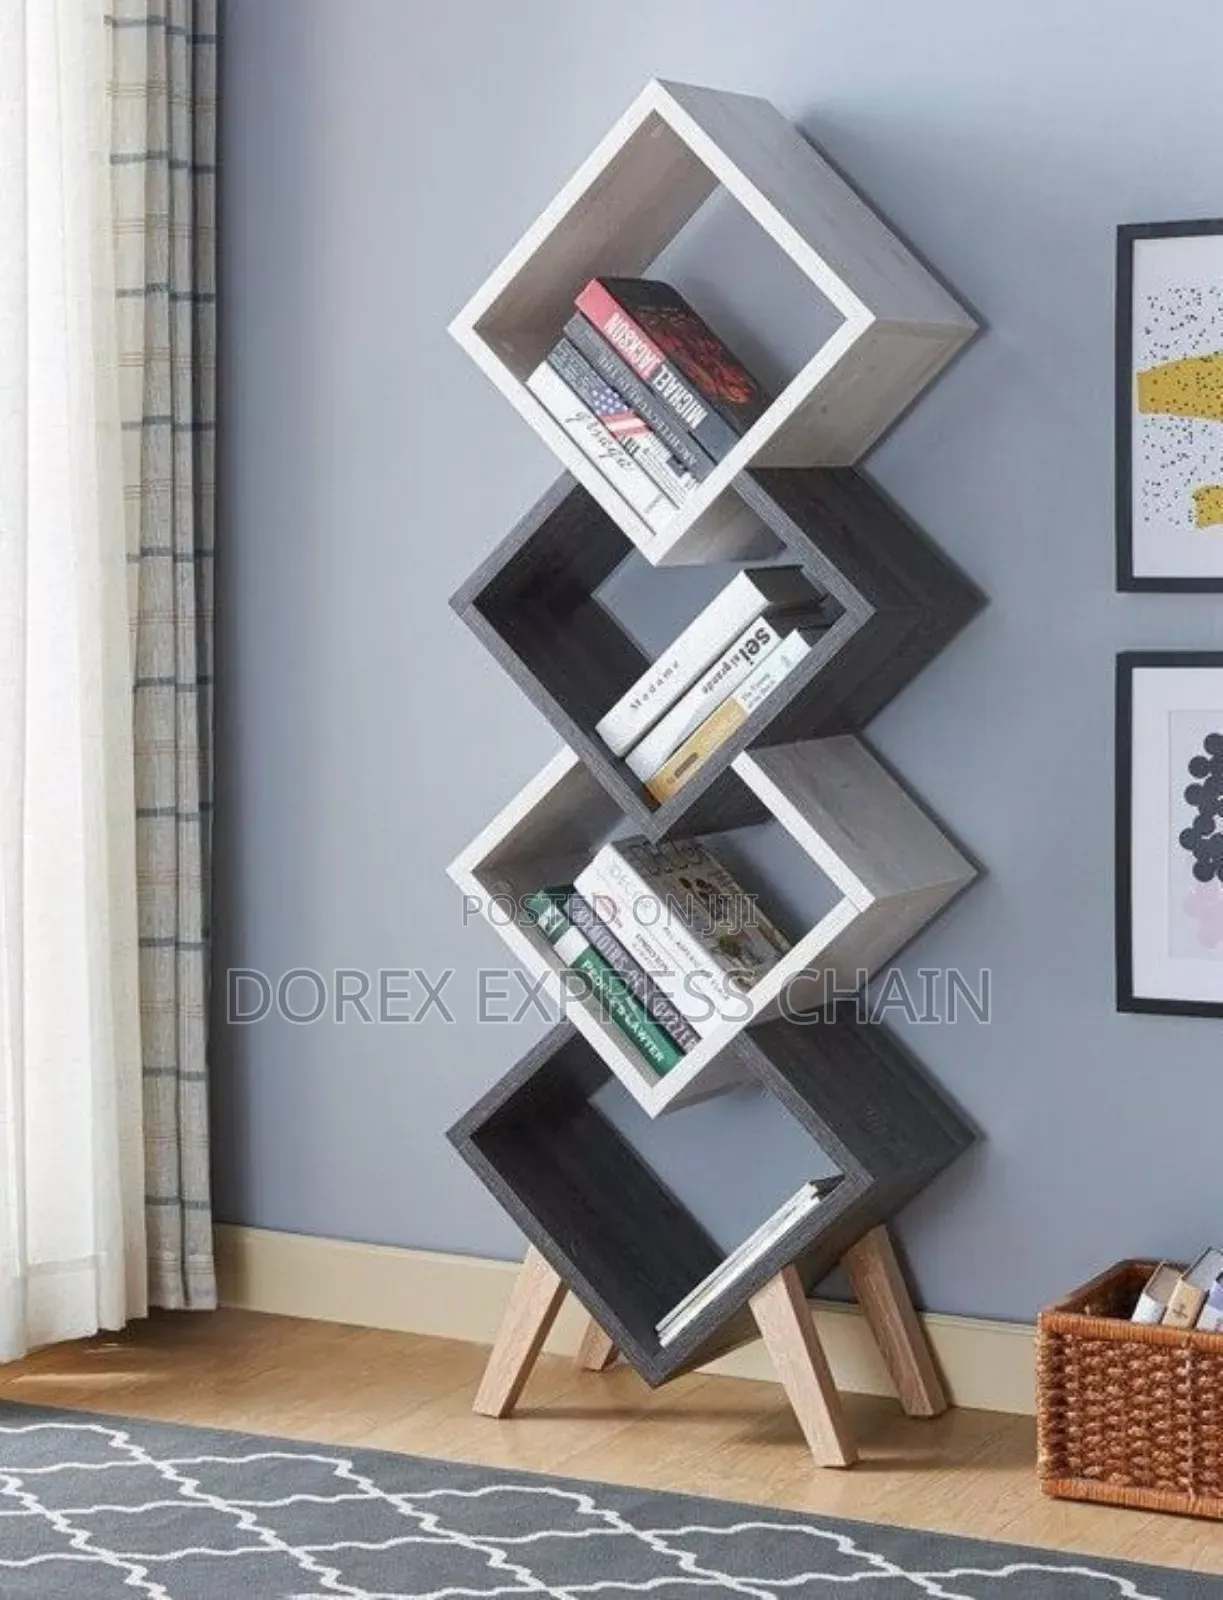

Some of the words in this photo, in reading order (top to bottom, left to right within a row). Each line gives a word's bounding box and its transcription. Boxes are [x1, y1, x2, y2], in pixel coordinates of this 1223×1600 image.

[600, 311, 664, 378] JACKSON
[648, 364, 709, 429] MICHAEL
[737, 626, 775, 666] sei
